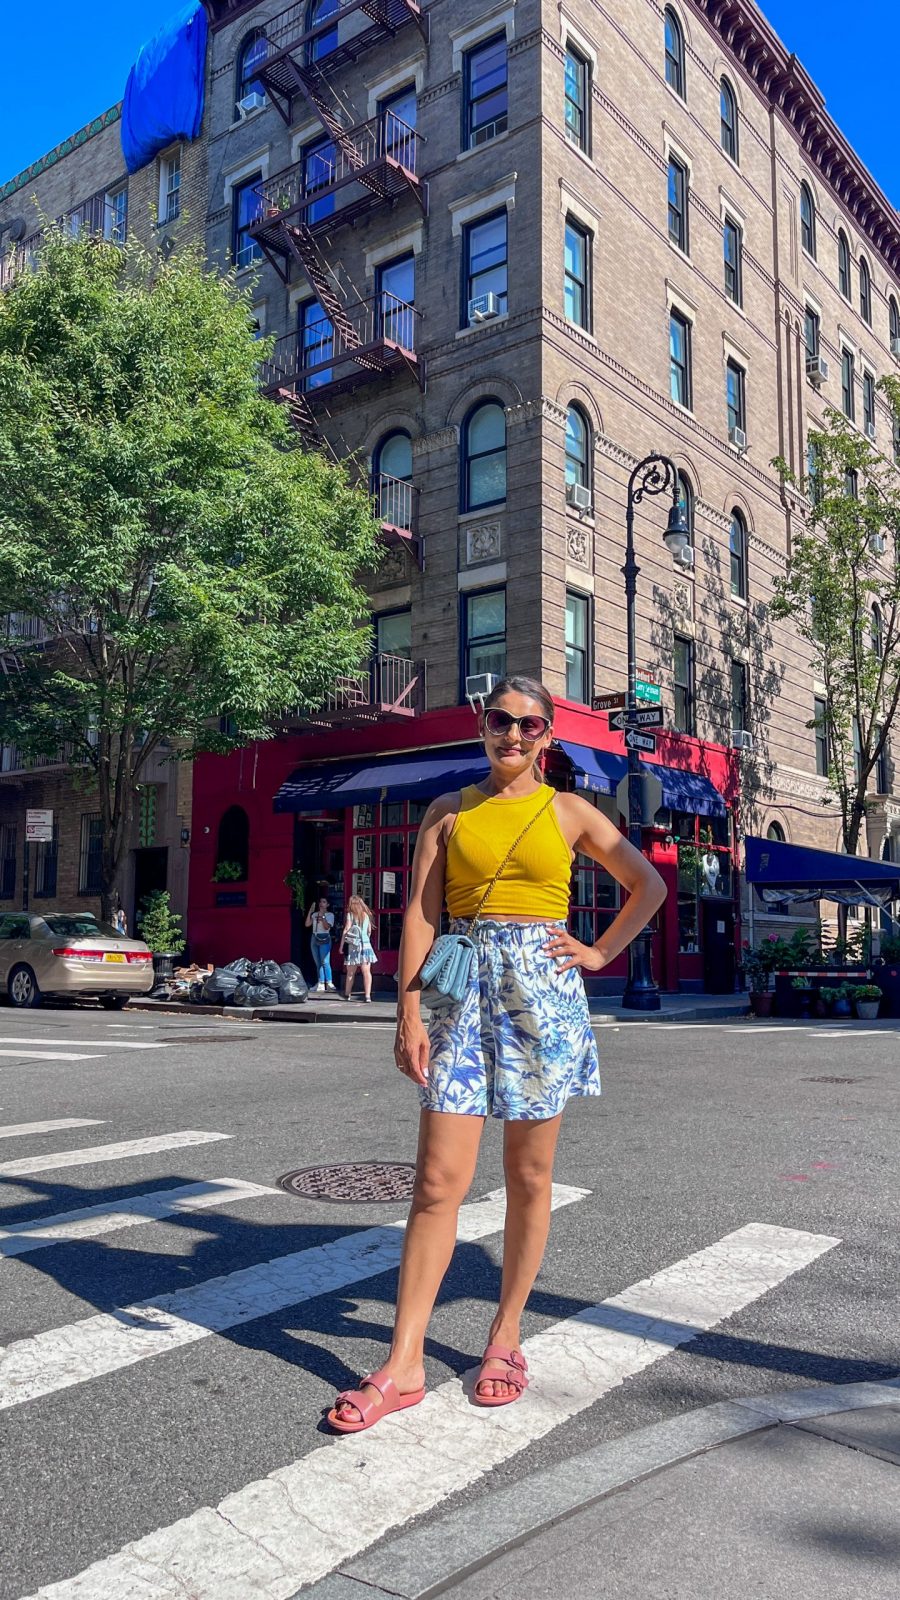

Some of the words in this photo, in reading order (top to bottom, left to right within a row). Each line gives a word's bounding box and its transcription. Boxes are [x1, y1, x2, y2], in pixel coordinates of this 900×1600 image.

[593, 700, 611, 710] Grove
[640, 713, 656, 722] WAY
[629, 734, 639, 744] ONE
[642, 738, 652, 746] WAY
